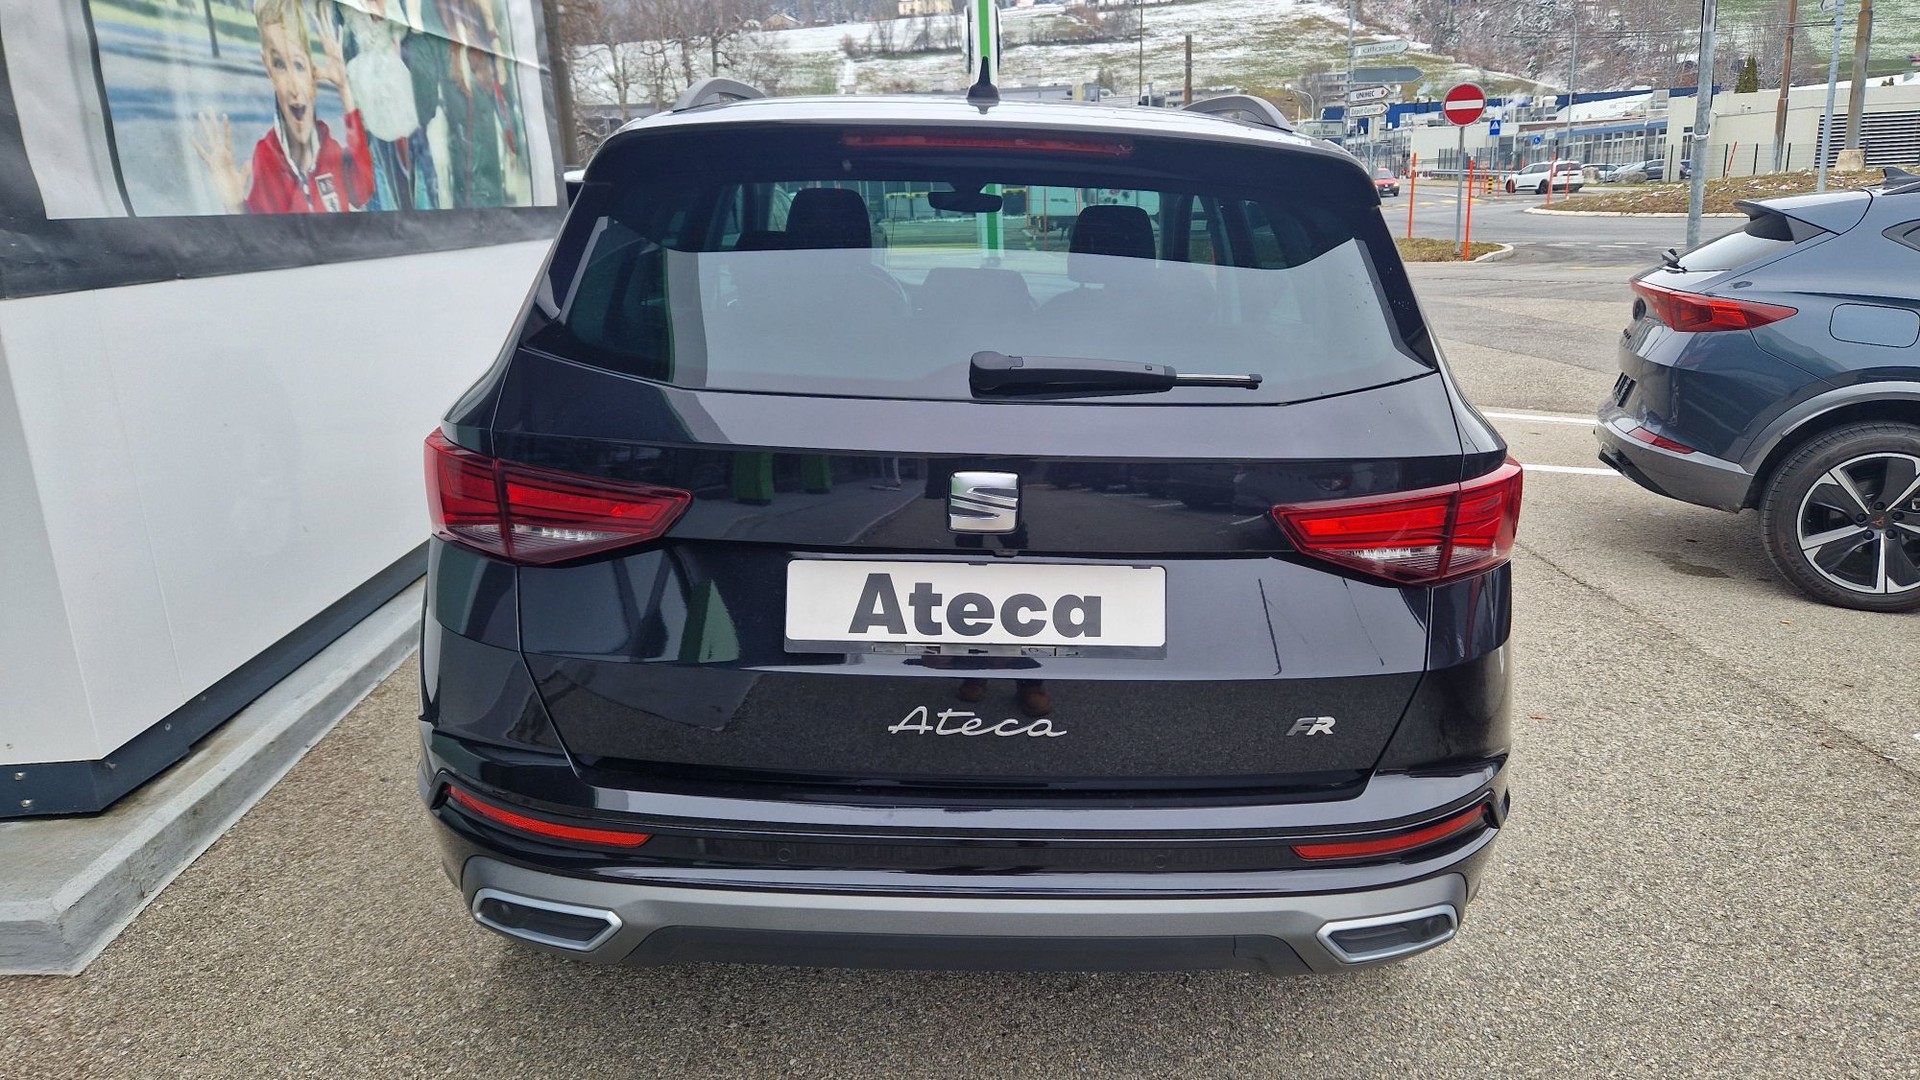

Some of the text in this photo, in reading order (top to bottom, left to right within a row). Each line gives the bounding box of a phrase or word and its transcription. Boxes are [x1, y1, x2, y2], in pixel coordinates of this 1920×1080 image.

[848, 572, 1102, 638] Ateca
[887, 705, 1067, 738] Ateca
[1285, 716, 1336, 736] FR
